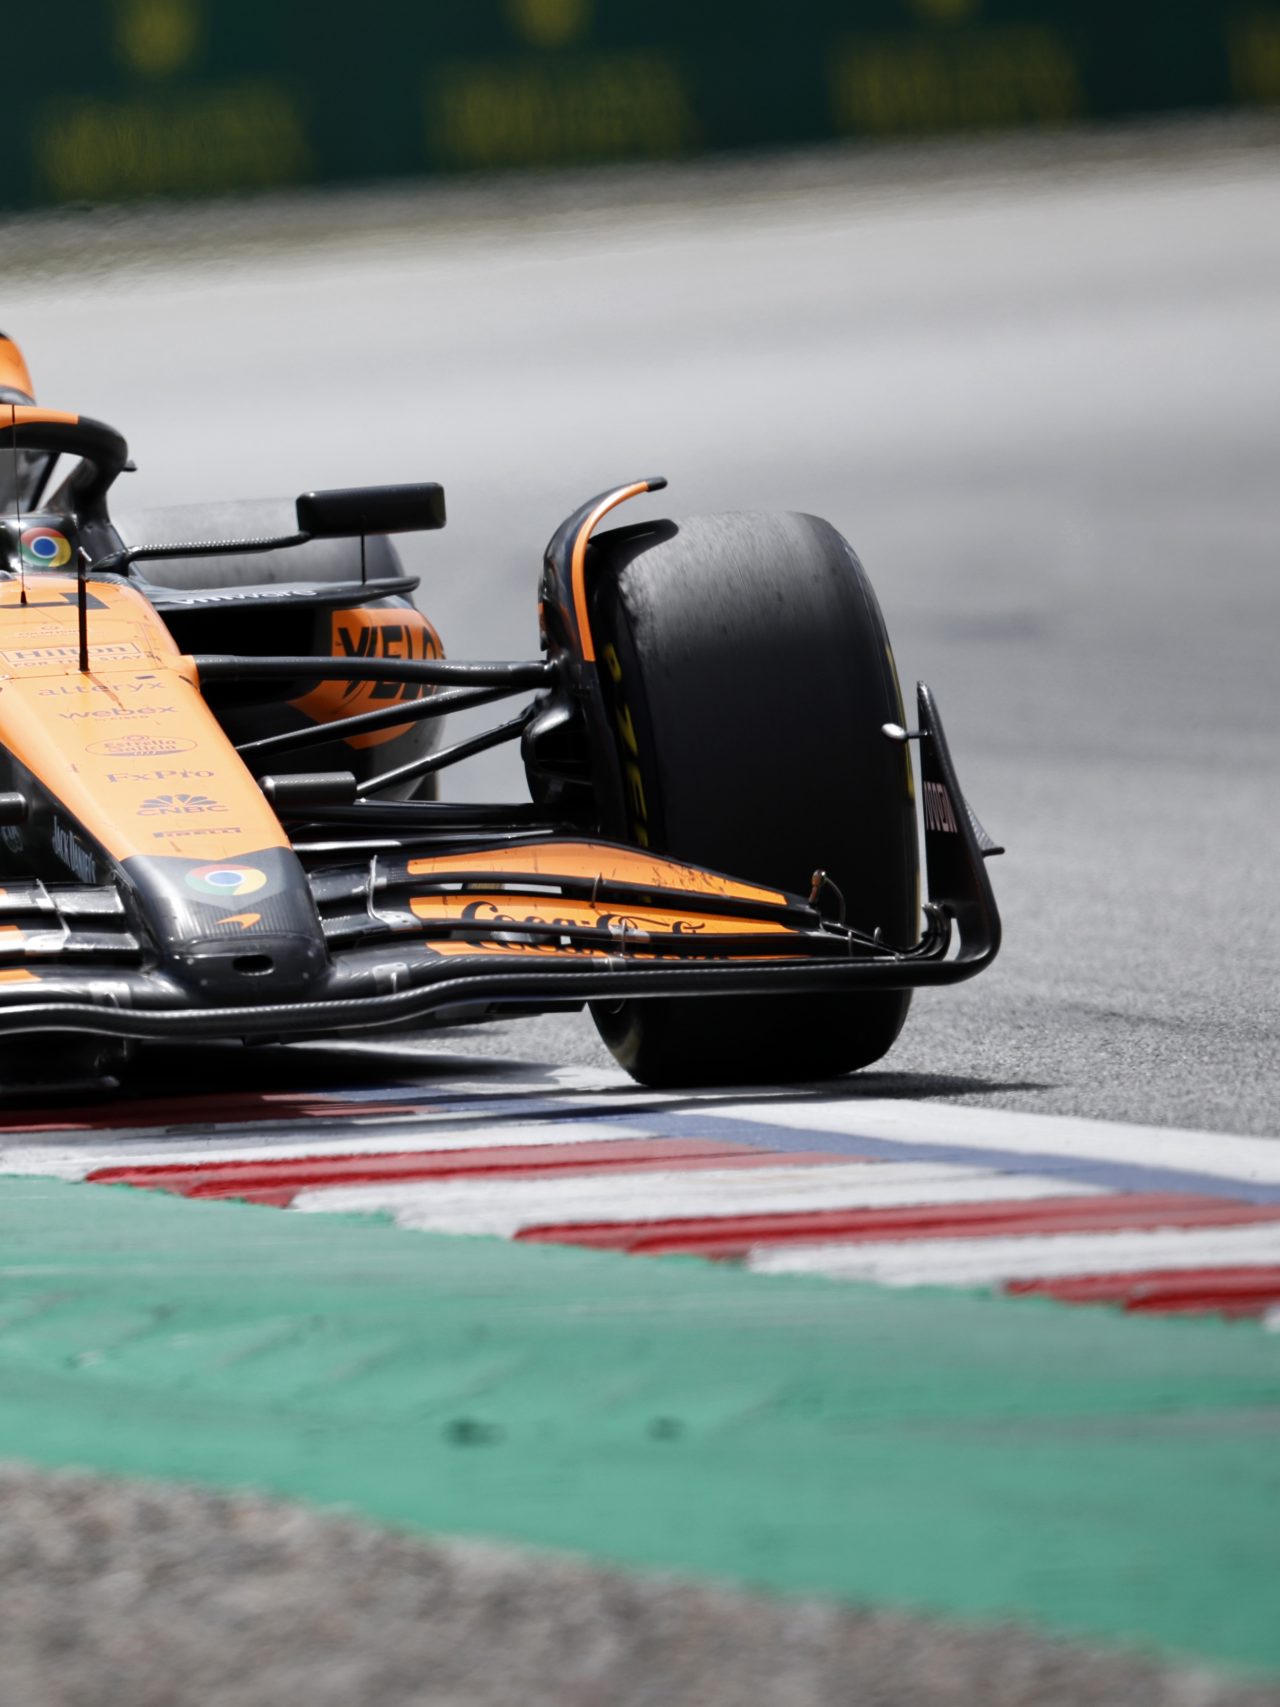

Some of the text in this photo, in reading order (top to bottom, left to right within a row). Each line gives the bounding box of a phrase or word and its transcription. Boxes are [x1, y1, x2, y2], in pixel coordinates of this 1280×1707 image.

[38, 680, 166, 697] alteryx
[58, 705, 176, 720] webex
[107, 769, 214, 782] FxPro
[136, 804, 229, 816] CNBC
